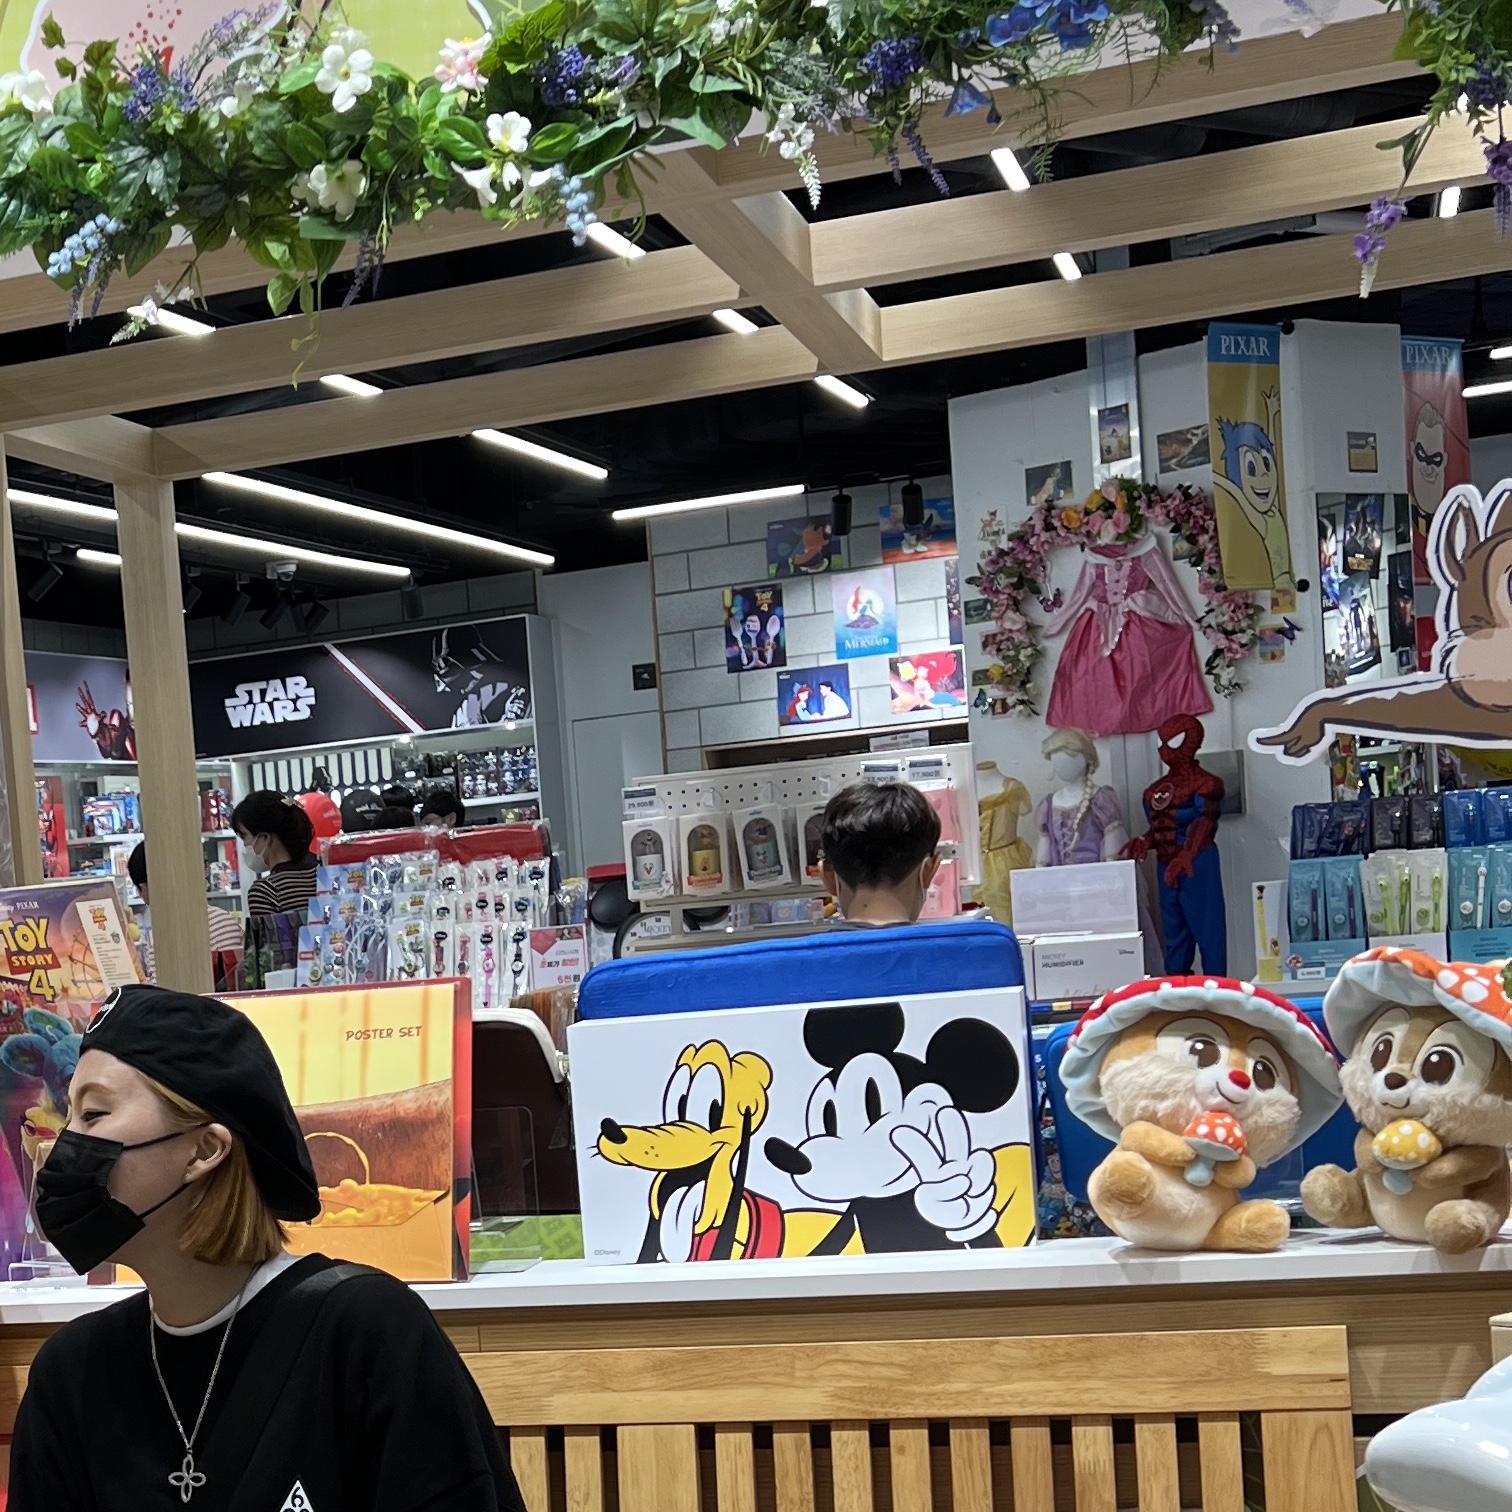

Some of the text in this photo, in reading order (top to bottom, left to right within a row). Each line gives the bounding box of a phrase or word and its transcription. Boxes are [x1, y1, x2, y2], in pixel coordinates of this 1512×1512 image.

[1220, 335, 1270, 357] PIXAR
[1405, 345, 1451, 365] PIXAR
[224, 676, 316, 706] STAR
[225, 697, 316, 729] WARS
[16, 901, 39, 910] PIXAR
[12, 953, 54, 967] STORY
[28, 968, 55, 1002] 4
[346, 1025, 422, 1041] POSTER SET
